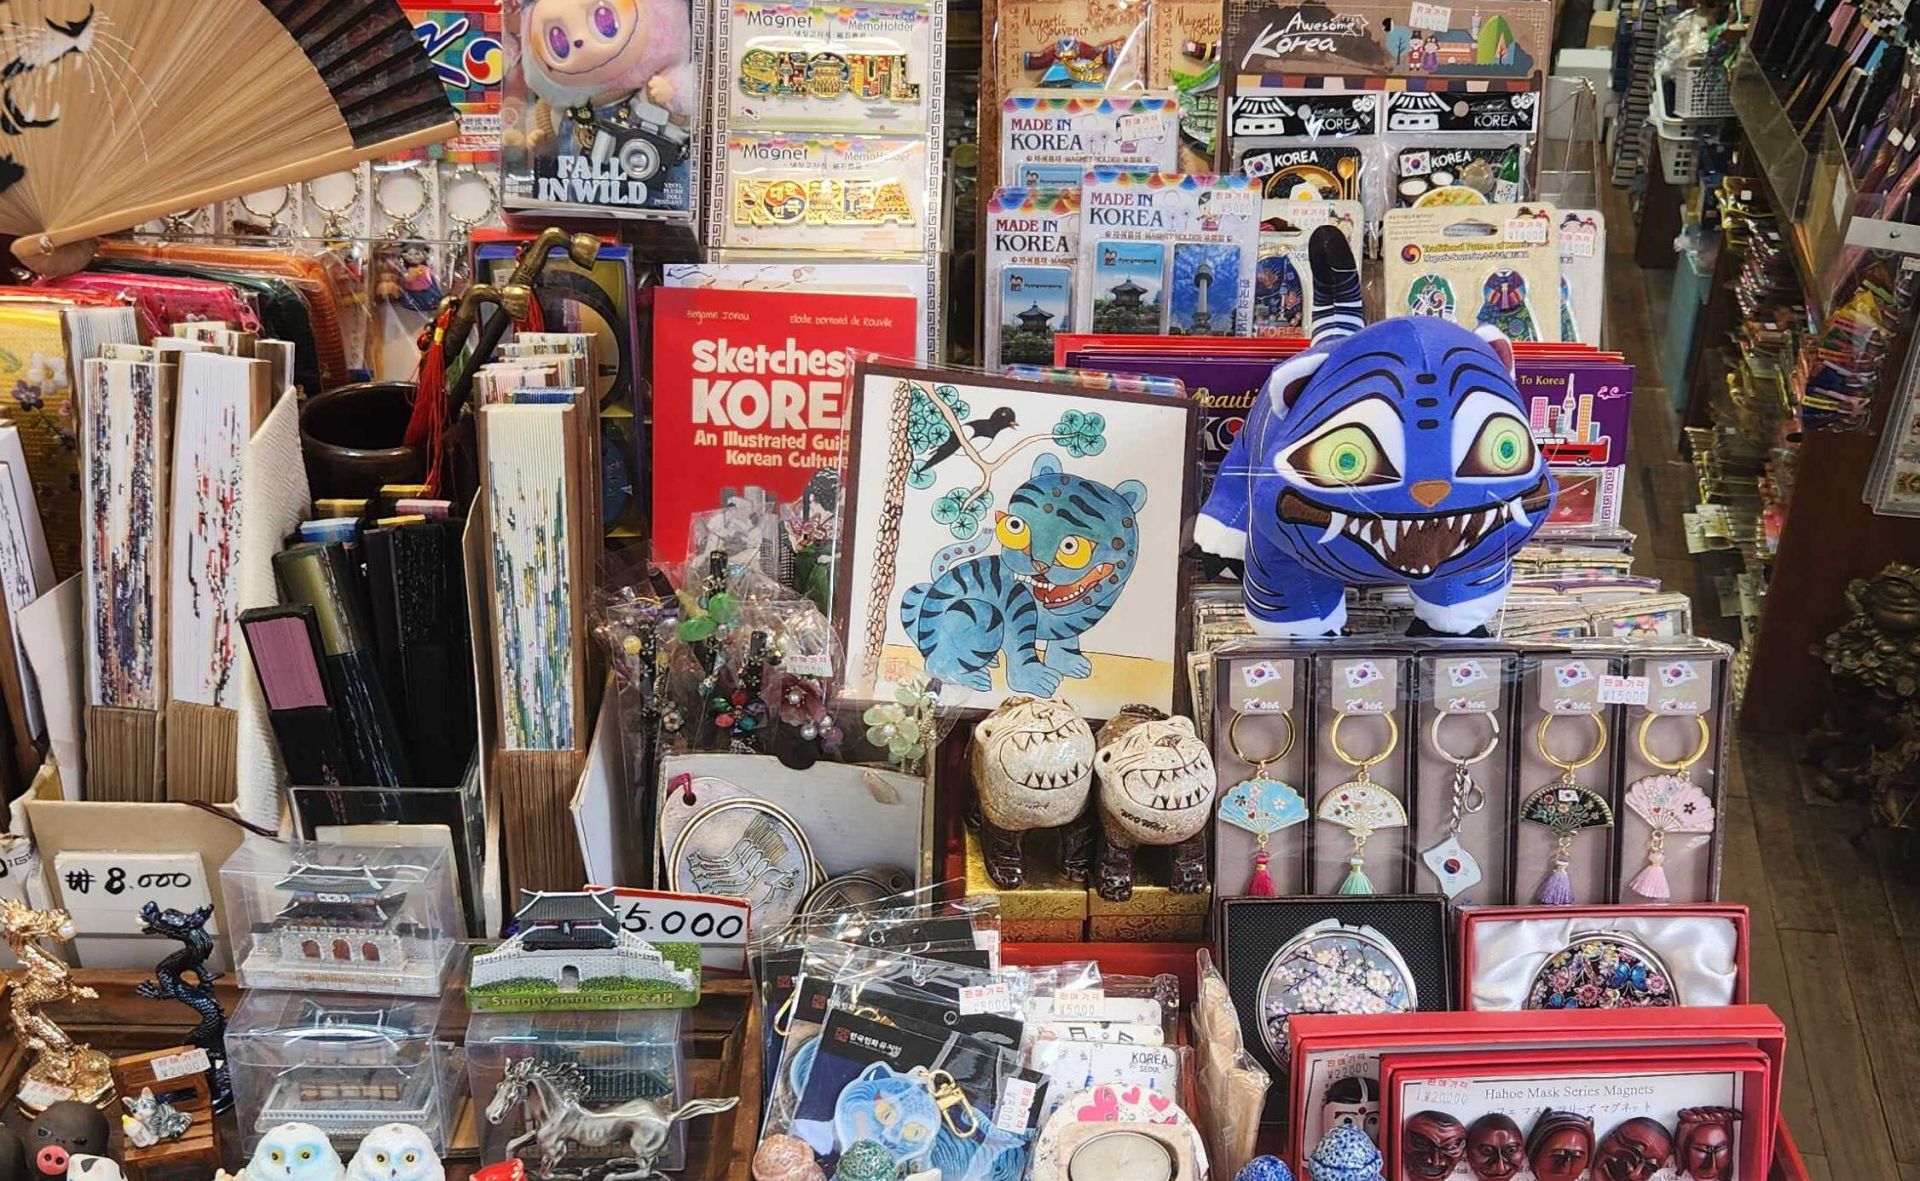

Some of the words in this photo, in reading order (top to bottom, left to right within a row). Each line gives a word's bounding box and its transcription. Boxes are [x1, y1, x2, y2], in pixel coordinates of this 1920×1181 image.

[747, 10, 813, 29] Magnet
[848, 20, 914, 32] MemoHolder
[1022, 6, 1067, 36] Magnetic
[1176, 6, 1221, 35] Magnetic
[1285, 12, 1355, 33] Awesome
[1038, 24, 1088, 42] Souvenir
[1189, 26, 1223, 41] Souv
[1241, 24, 1337, 70] Korea
[738, 48, 921, 105] SEOUL
[1011, 118, 1053, 131] MADE
[1057, 118, 1072, 131] IN
[1317, 119, 1361, 132] KOREA
[1473, 115, 1518, 127] KOREA
[1011, 133, 1083, 151] KOREA
[742, 144, 808, 160] Magnet
[1274, 150, 1319, 166] KOREA
[1430, 150, 1472, 168] KOREA
[558, 155, 627, 180] FALL
[538, 177, 568, 202] IN
[572, 178, 648, 204] WILD
[1091, 192, 1134, 206] MADE
[1137, 193, 1153, 207] IN
[995, 219, 1039, 232] MADE
[1043, 220, 1058, 232] IN
[1090, 207, 1163, 227] KOREA
[995, 234, 1070, 252] KOREA
[692, 337, 846, 378] Sketches
[1521, 374, 1533, 385] To
[1536, 374, 1565, 385] Korea
[692, 378, 850, 430] KORE
[1191, 386, 1257, 410] Beauti
[694, 430, 717, 447] An
[723, 431, 806, 450] Illustrated
[812, 434, 850, 451] Guid
[726, 449, 783, 467] Korean
[788, 452, 849, 469] Culture
[1243, 698, 1280, 711] Korea
[1346, 698, 1383, 711] Korea
[1449, 698, 1487, 710] Korea
[1554, 698, 1592, 710] Korea
[1660, 698, 1697, 710] Korea
[104, 867, 192, 895] 8.000
[620, 902, 743, 939] 5.000
[1131, 1052, 1169, 1065] KOREA
[1139, 1065, 1161, 1073] SEOUL
[1485, 1088, 1524, 1100] Hahoe
[1527, 1086, 1560, 1099] Mask
[1563, 1085, 1600, 1098] Series
[1604, 1084, 1654, 1098] Magnets
